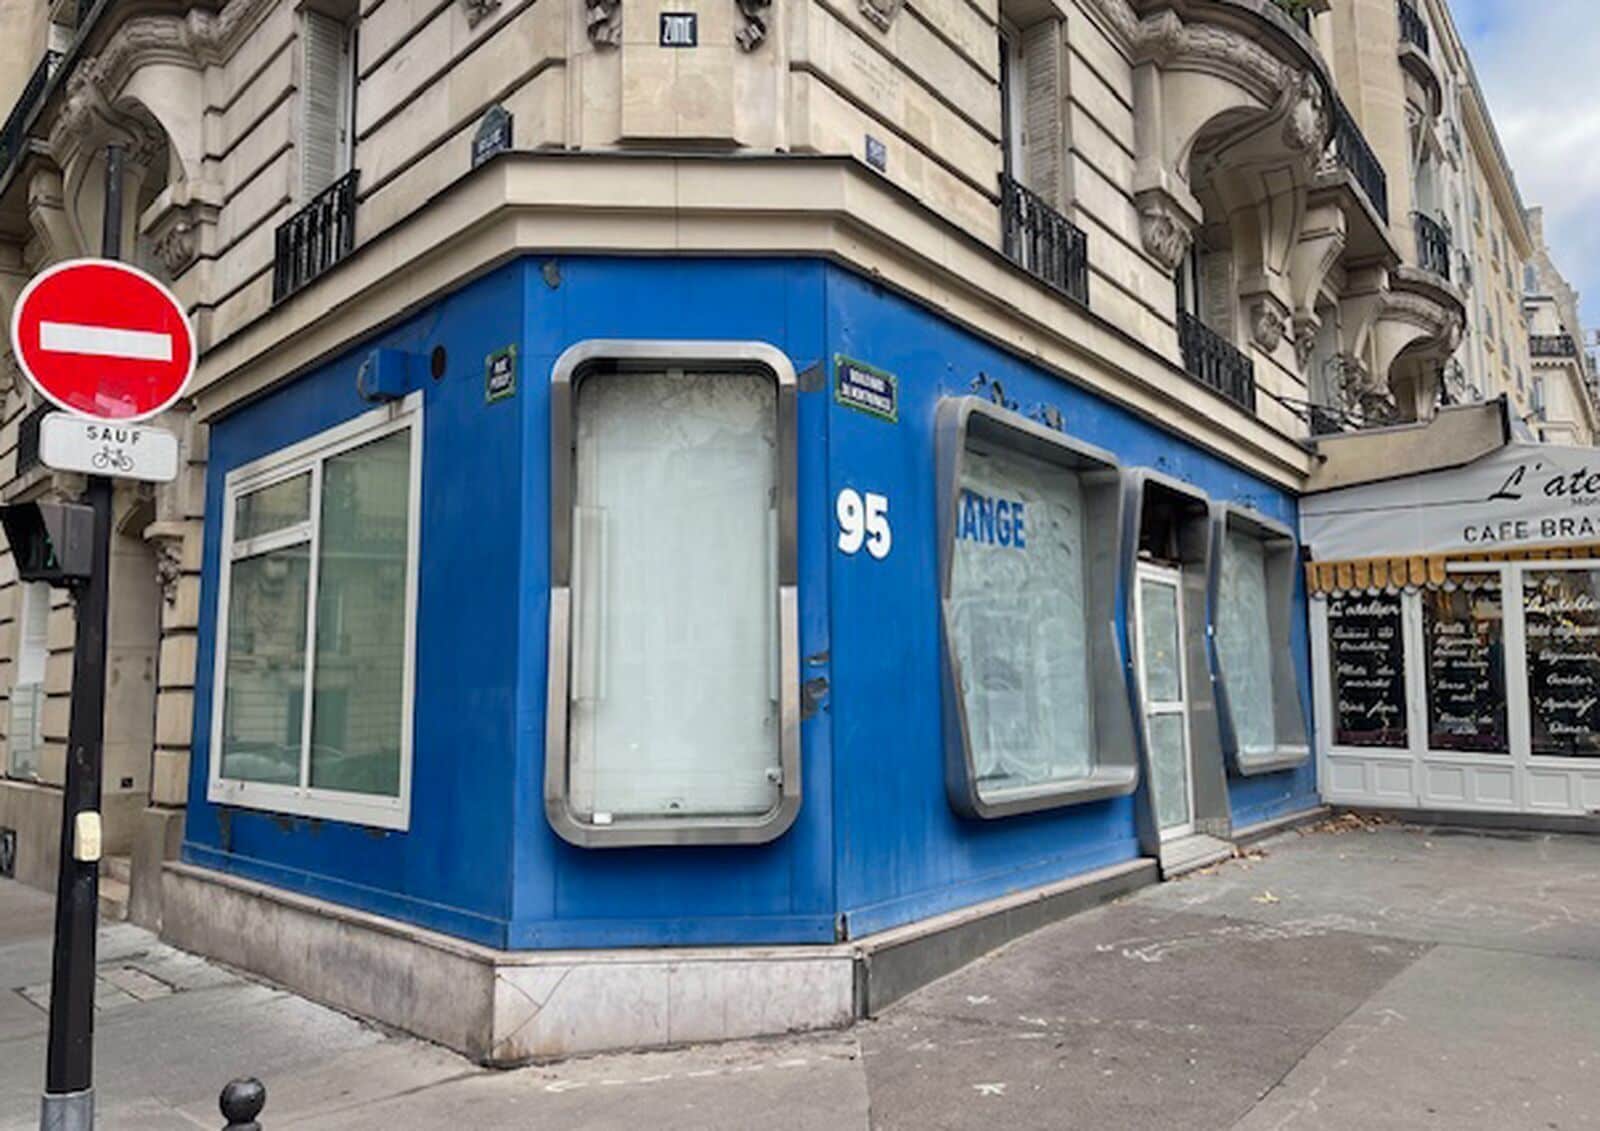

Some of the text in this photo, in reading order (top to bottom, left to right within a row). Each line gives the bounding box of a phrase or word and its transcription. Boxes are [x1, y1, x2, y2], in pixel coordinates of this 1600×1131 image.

[87, 425, 141, 446] SAUF
[836, 487, 892, 560] 95
[1463, 516, 1600, 543] CAFE BRA
